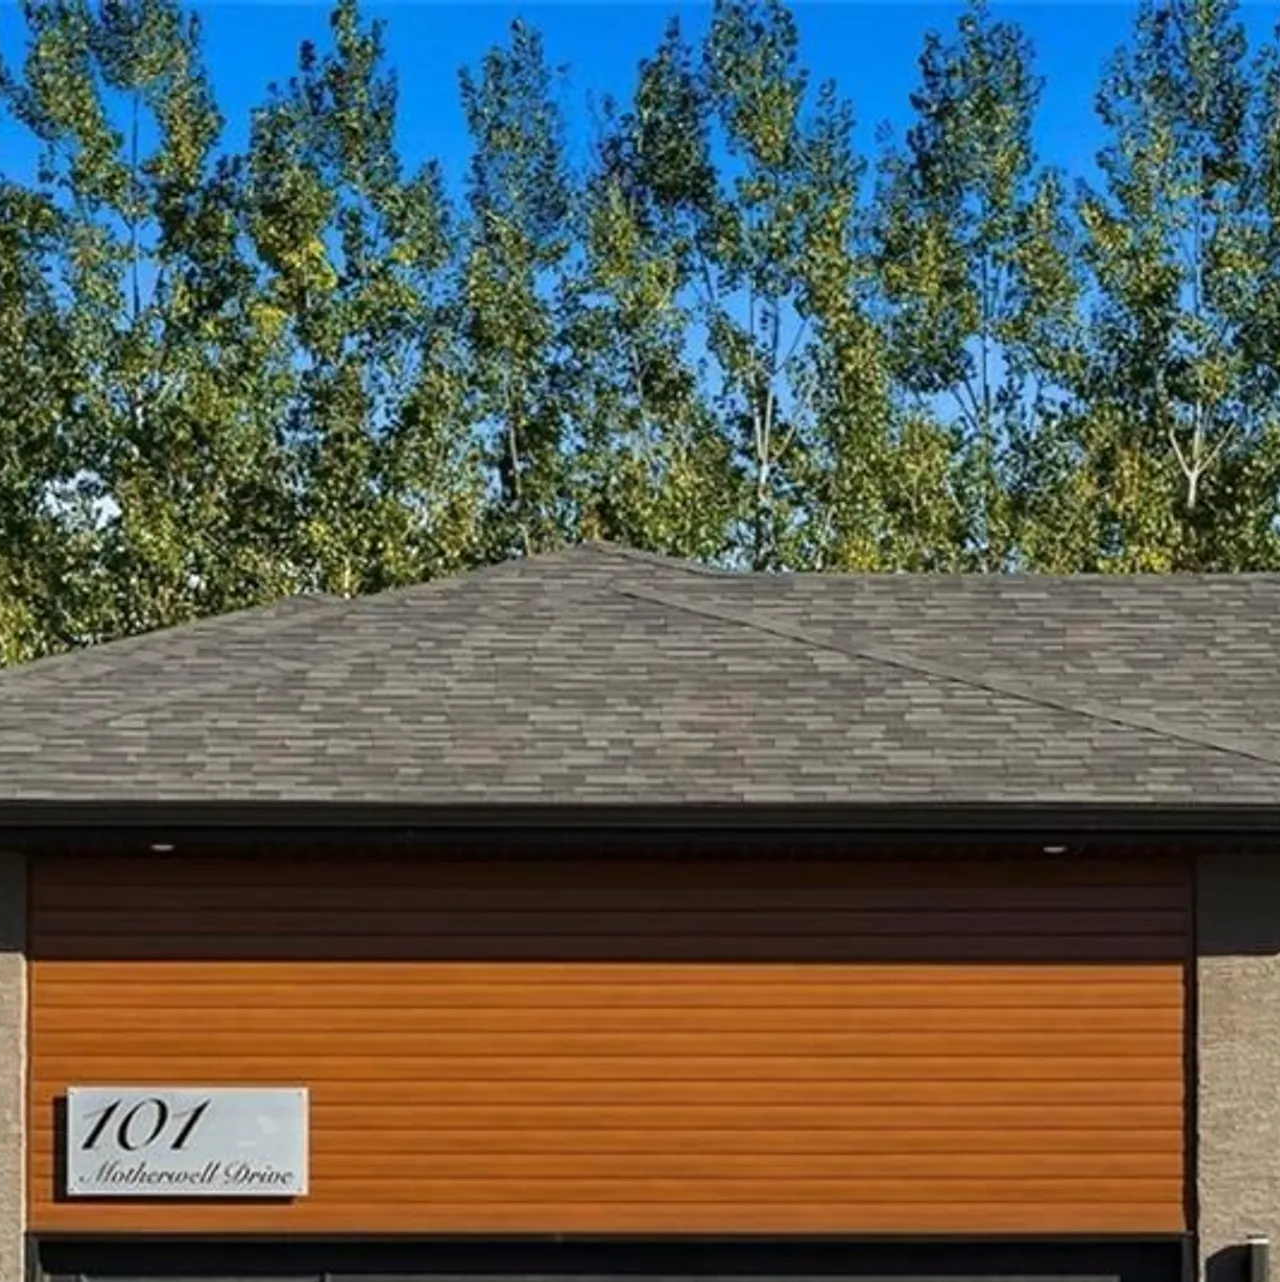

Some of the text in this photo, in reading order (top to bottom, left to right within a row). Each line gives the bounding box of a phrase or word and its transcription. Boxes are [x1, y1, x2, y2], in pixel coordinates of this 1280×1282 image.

[81, 1097, 213, 1151] 101
[79, 1160, 294, 1186] Motherwell Drive
